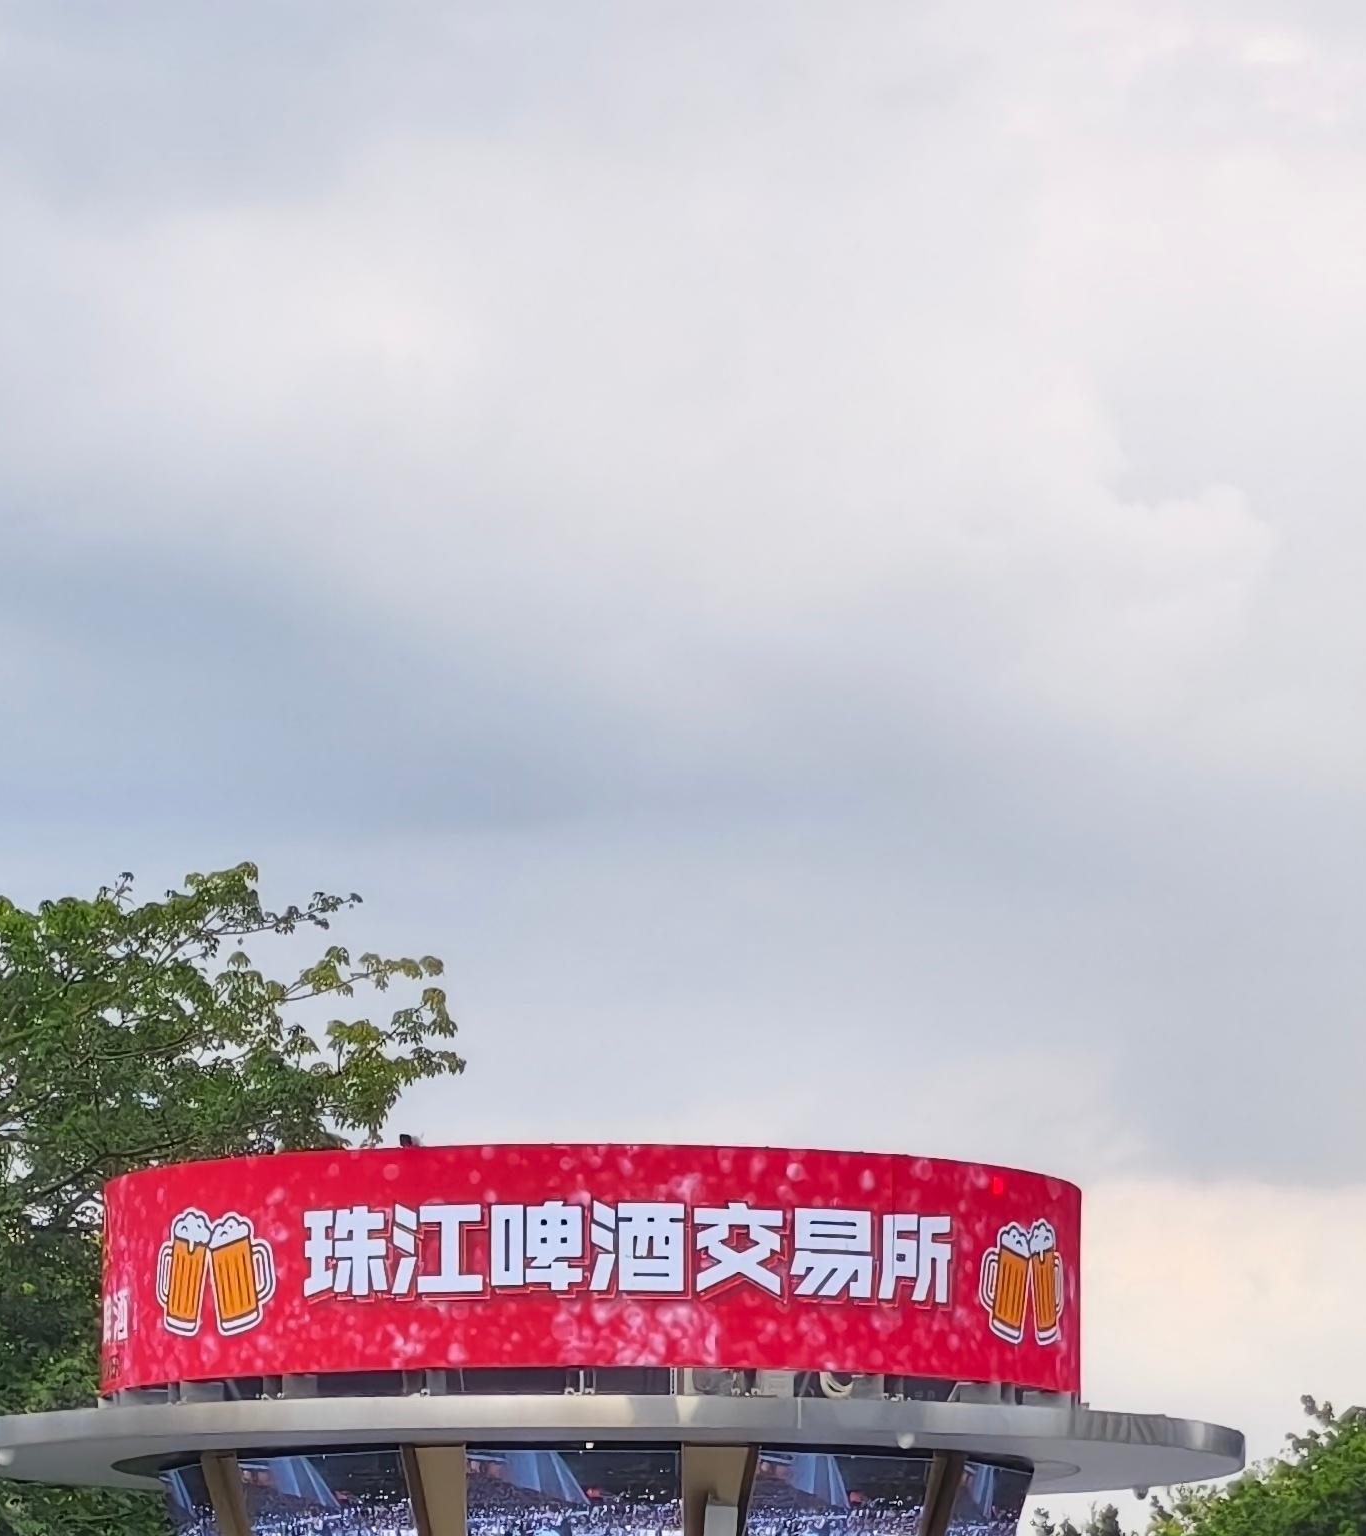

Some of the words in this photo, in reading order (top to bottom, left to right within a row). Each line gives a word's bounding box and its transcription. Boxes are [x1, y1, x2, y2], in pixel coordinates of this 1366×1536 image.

[302, 1201, 952, 1304] 珠江啤酒交易所
